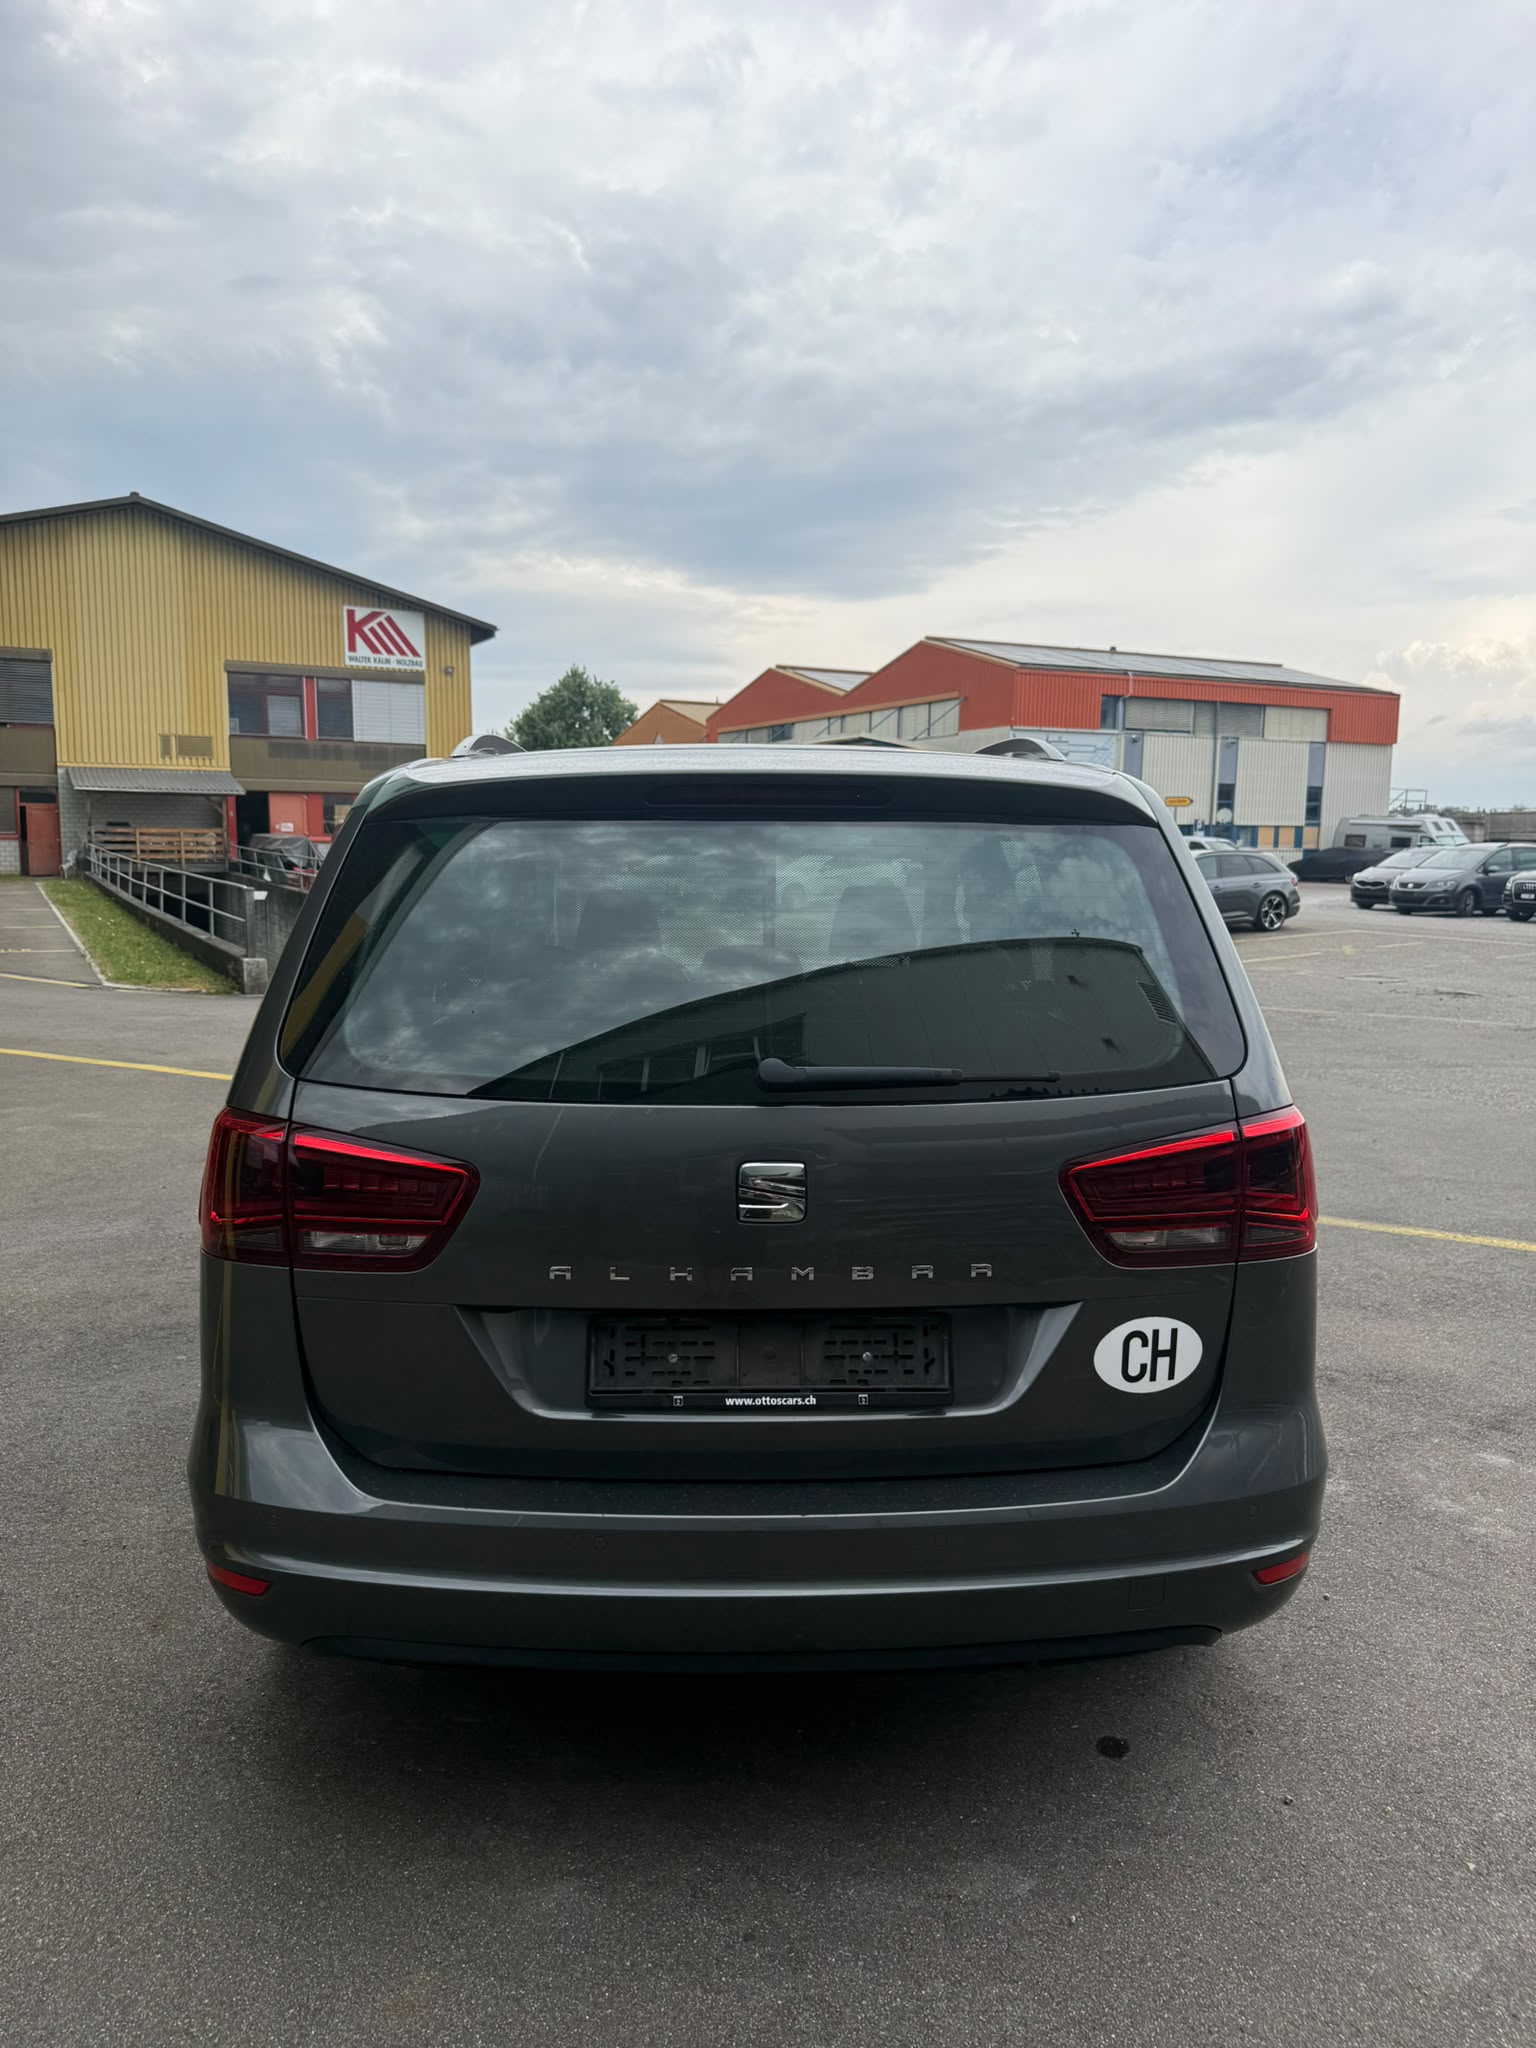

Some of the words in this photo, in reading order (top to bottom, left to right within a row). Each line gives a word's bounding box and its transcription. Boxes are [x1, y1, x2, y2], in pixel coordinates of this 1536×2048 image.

[549, 1263, 993, 1281] ALHAMBRA
[1121, 1328, 1178, 1383] CH
[725, 1395, 817, 1406] www.ottoscars.ch
